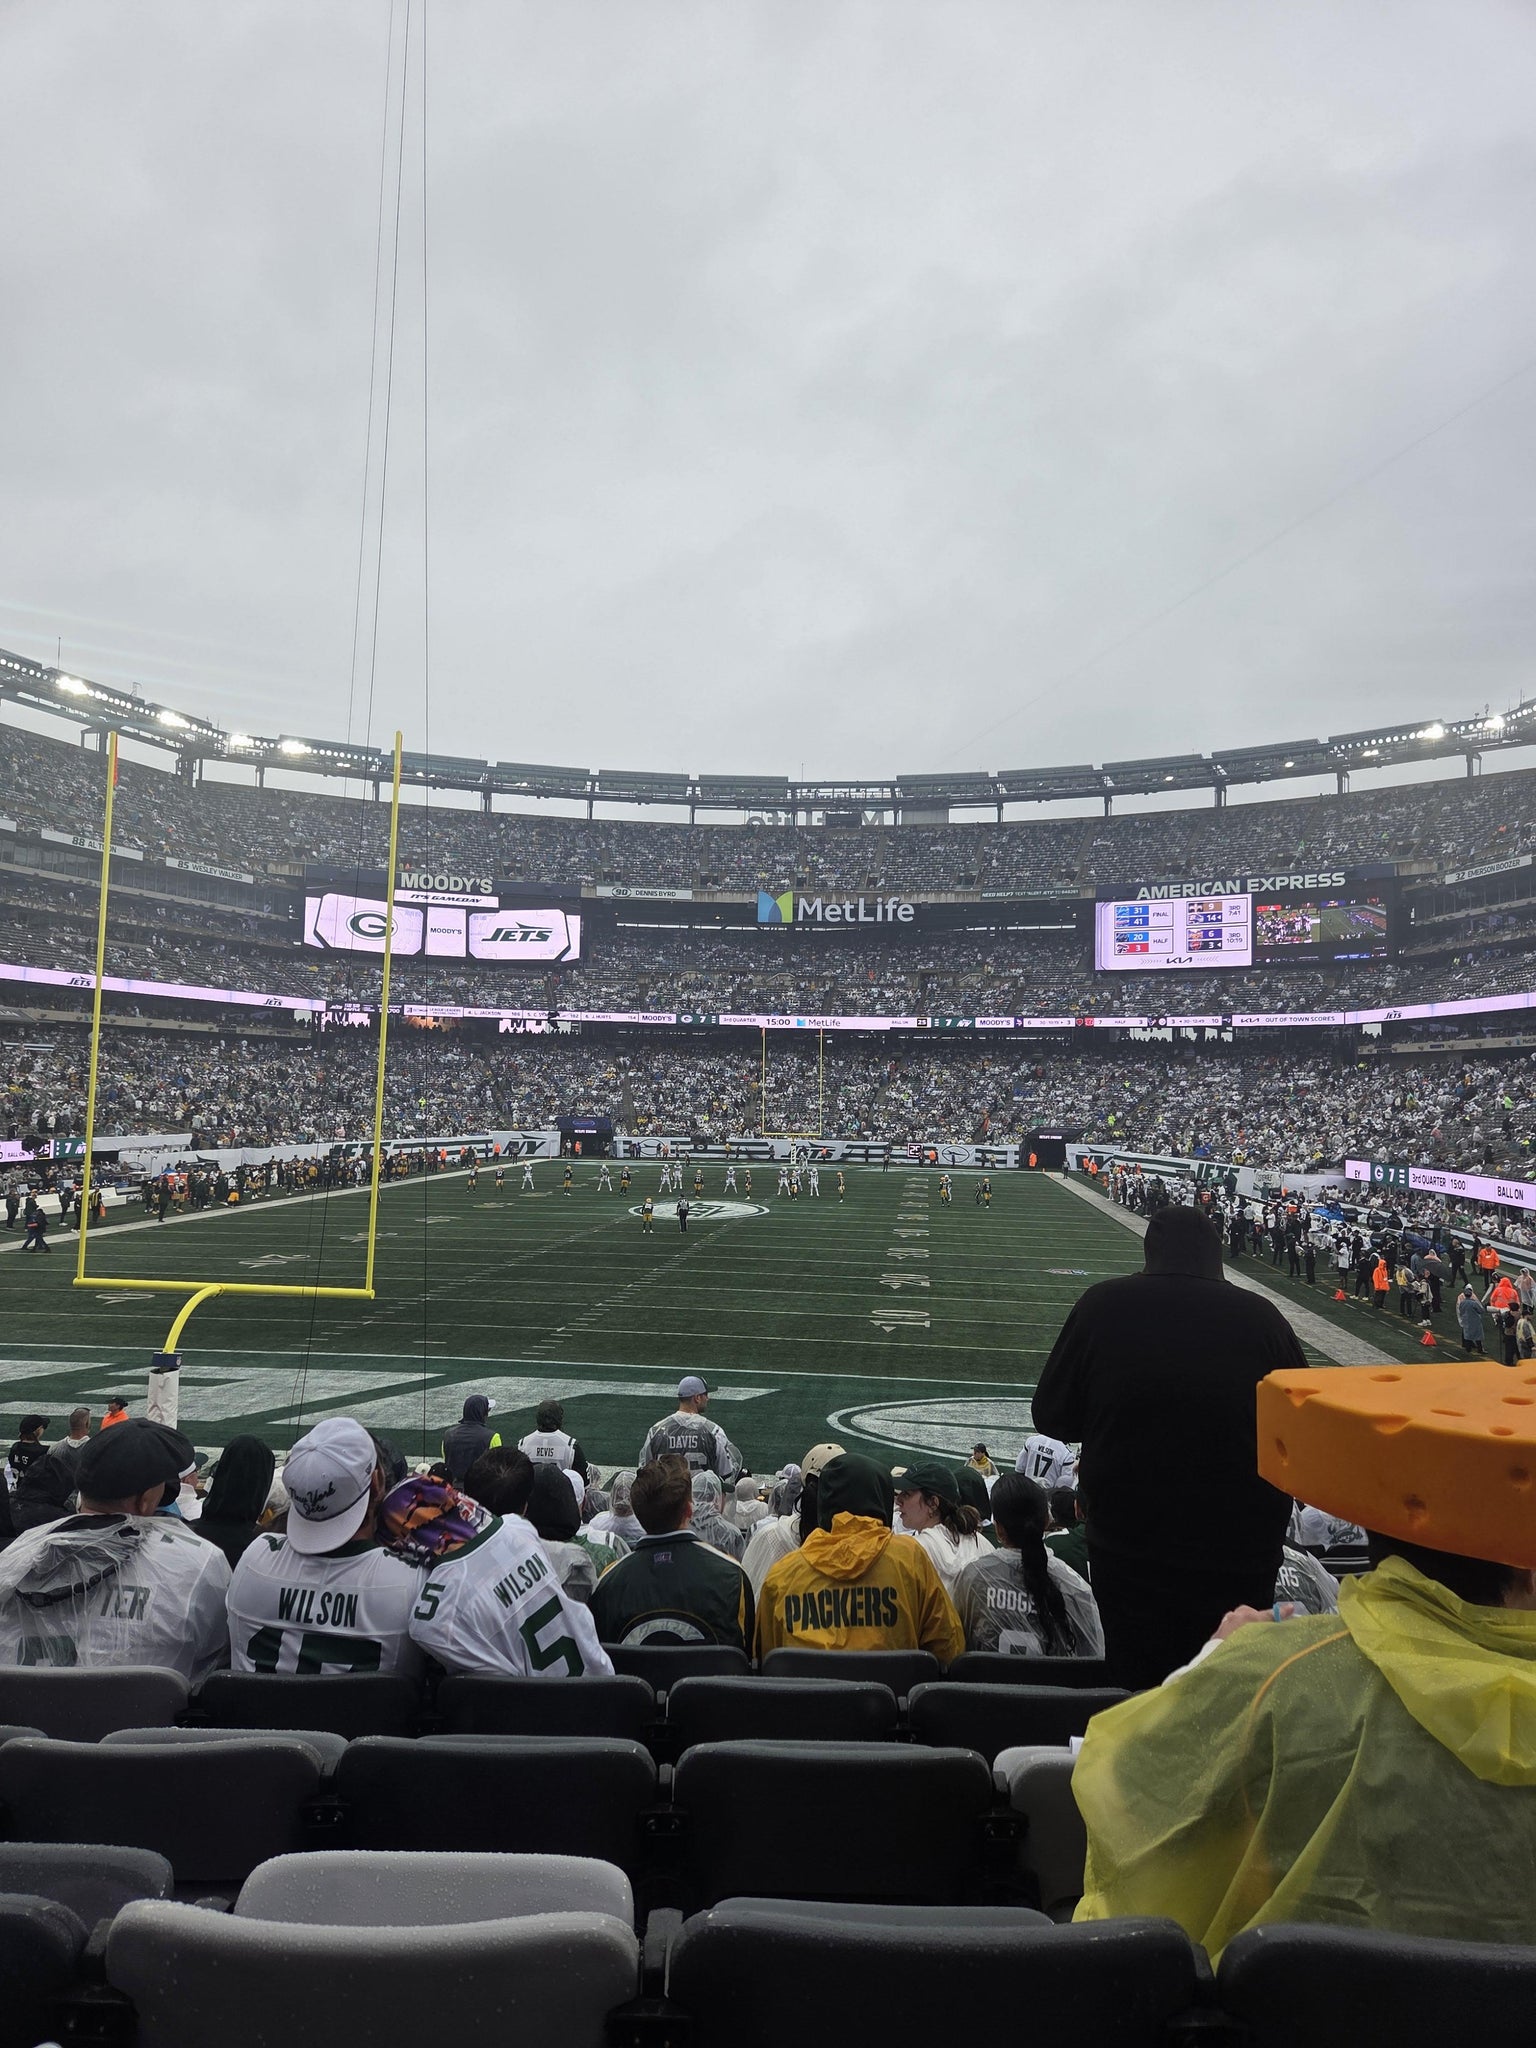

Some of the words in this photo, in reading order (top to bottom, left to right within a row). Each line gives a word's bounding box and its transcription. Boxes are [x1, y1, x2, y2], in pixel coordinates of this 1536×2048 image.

[72, 836, 85, 846] 88
[98, 843, 117, 853] TN
[177, 861, 189, 869] 85
[192, 864, 217, 874] WESLEY
[219, 870, 242, 880] WALKER
[1455, 872, 1466, 881] 32
[1468, 866, 1496, 877] EMERSON
[1497, 860, 1520, 870] BOOZER
[401, 873, 493, 894] MOODY'S
[1137, 880, 1241, 900] AMERICAN
[1247, 872, 1346, 893] EXPRESS
[431, 896, 482, 904] GAMEDAY
[798, 897, 915, 922] MetLife
[481, 922, 553, 942] JETS
[1167, 956, 1192, 964] KIA
[67, 976, 91, 987] JETS
[263, 997, 283, 1006] JETS
[1384, 1010, 1402, 1020] JETS
[809, 1019, 841, 1027] MetLife
[65, 1143, 72, 1154] 7
[910, 1146, 920, 1154] 25
[1354, 1170, 1361, 1179] EY
[1388, 1168, 1395, 1182] 7
[1412, 1173, 1421, 1184] 3rd
[1422, 1175, 1446, 1187] QUARTER
[1450, 1179, 1466, 1190] 15:00
[1497, 1186, 1513, 1199] BALL
[1514, 1188, 1524, 1200] ON
[669, 1435, 698, 1449] DAVIS
[536, 1447, 554, 1457] REVIS
[1038, 1444, 1054, 1456] WILSON
[1033, 1454, 1053, 1478] 17
[492, 1553, 549, 1609] WILSON
[278, 1587, 358, 1628] WILSON
[414, 1582, 446, 1622] 5
[784, 1586, 899, 1634] PACKERS
[519, 1596, 586, 1677] 5
